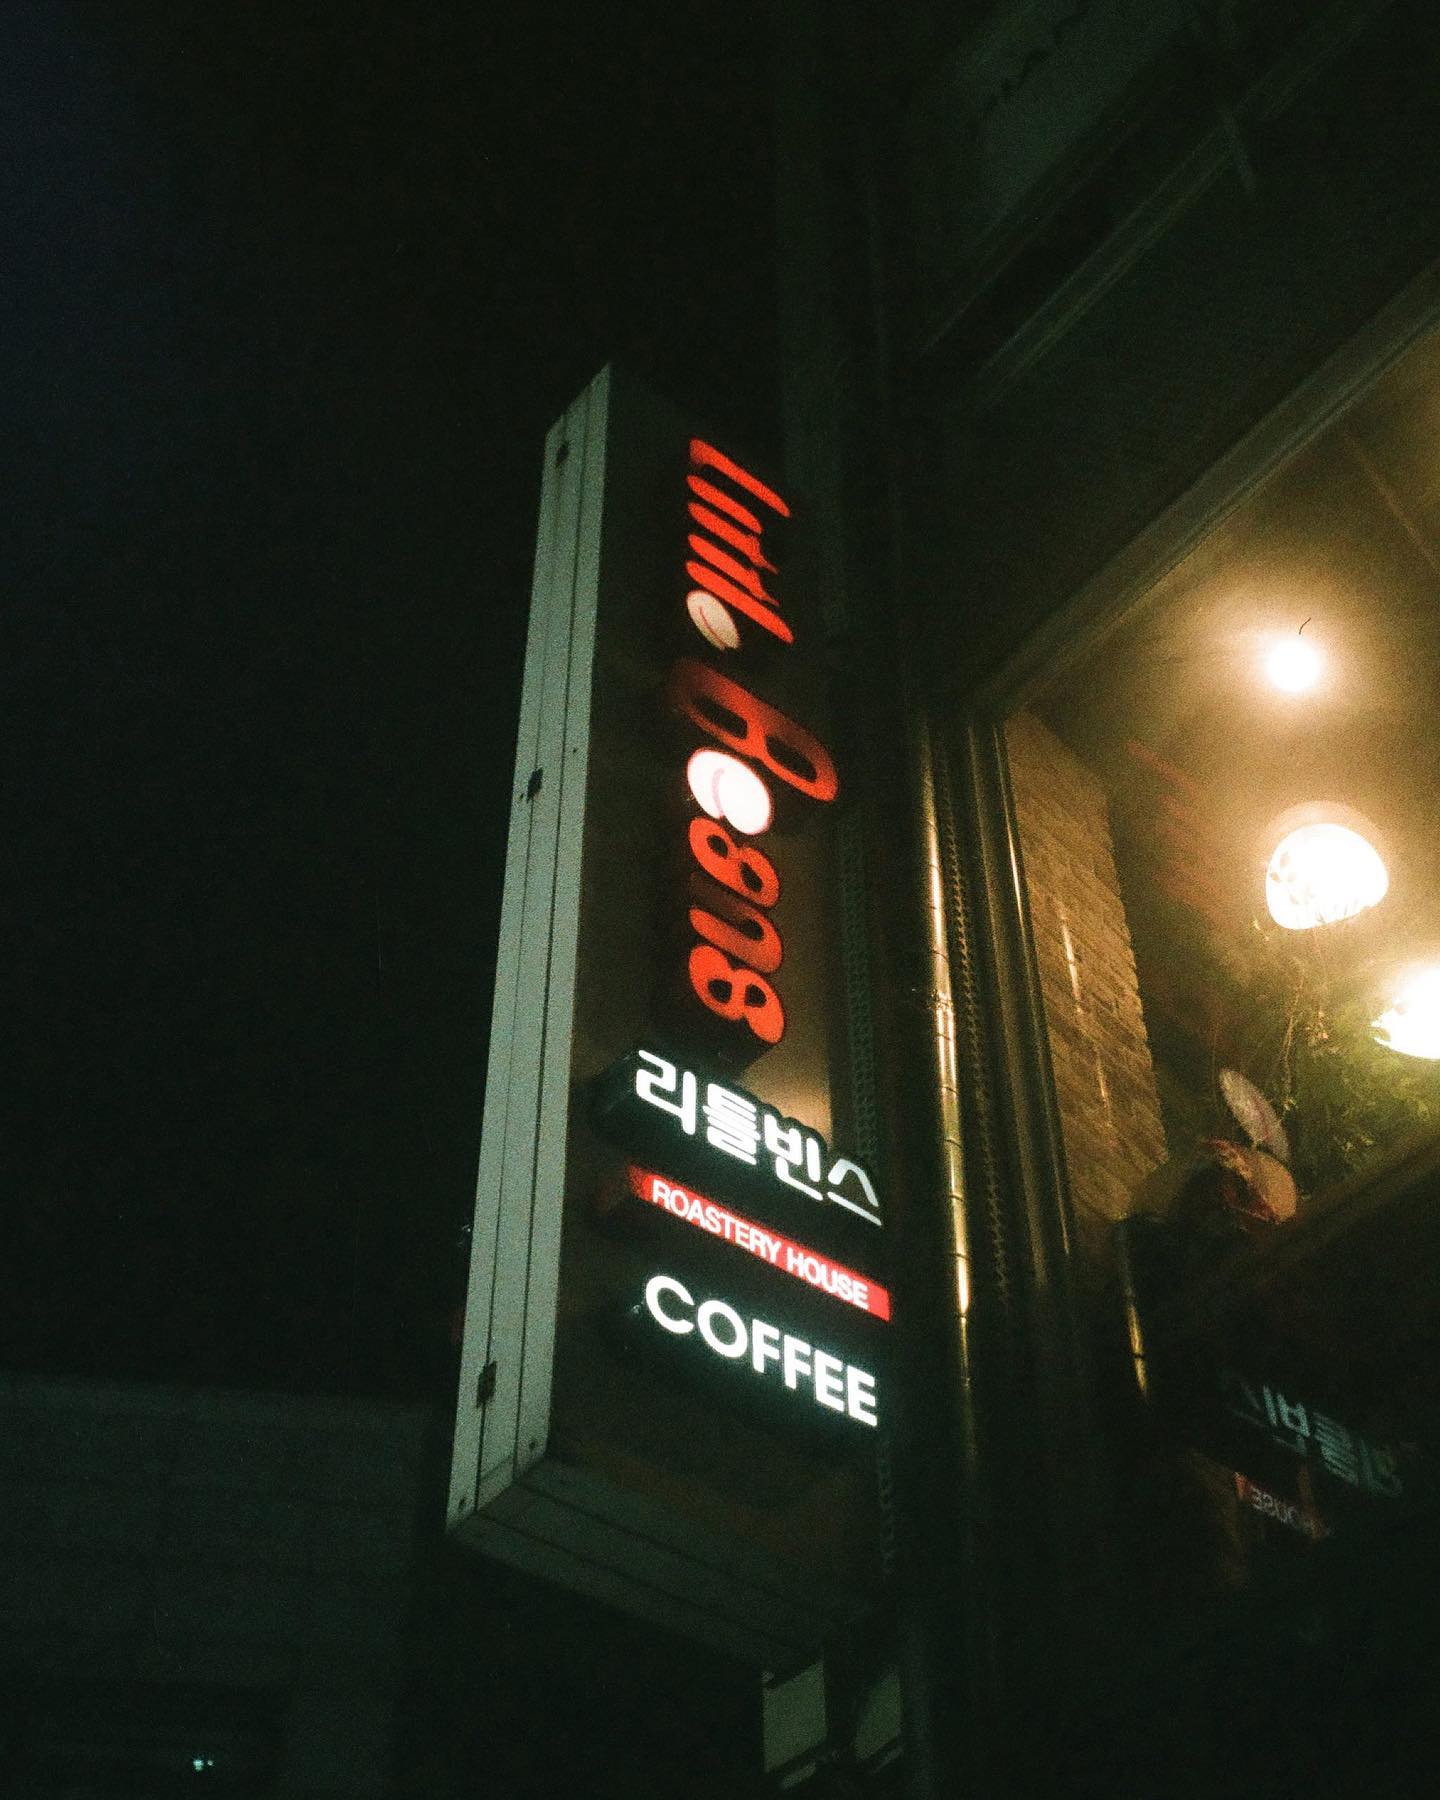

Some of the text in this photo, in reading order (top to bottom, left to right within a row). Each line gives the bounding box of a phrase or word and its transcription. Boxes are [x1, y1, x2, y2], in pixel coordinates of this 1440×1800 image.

[668, 657, 839, 1046] Beans
[635, 1049, 882, 1227] 리틀빈스
[651, 1179, 870, 1311] ROASTERY HOUSE
[645, 1275, 878, 1427] COFFEE
